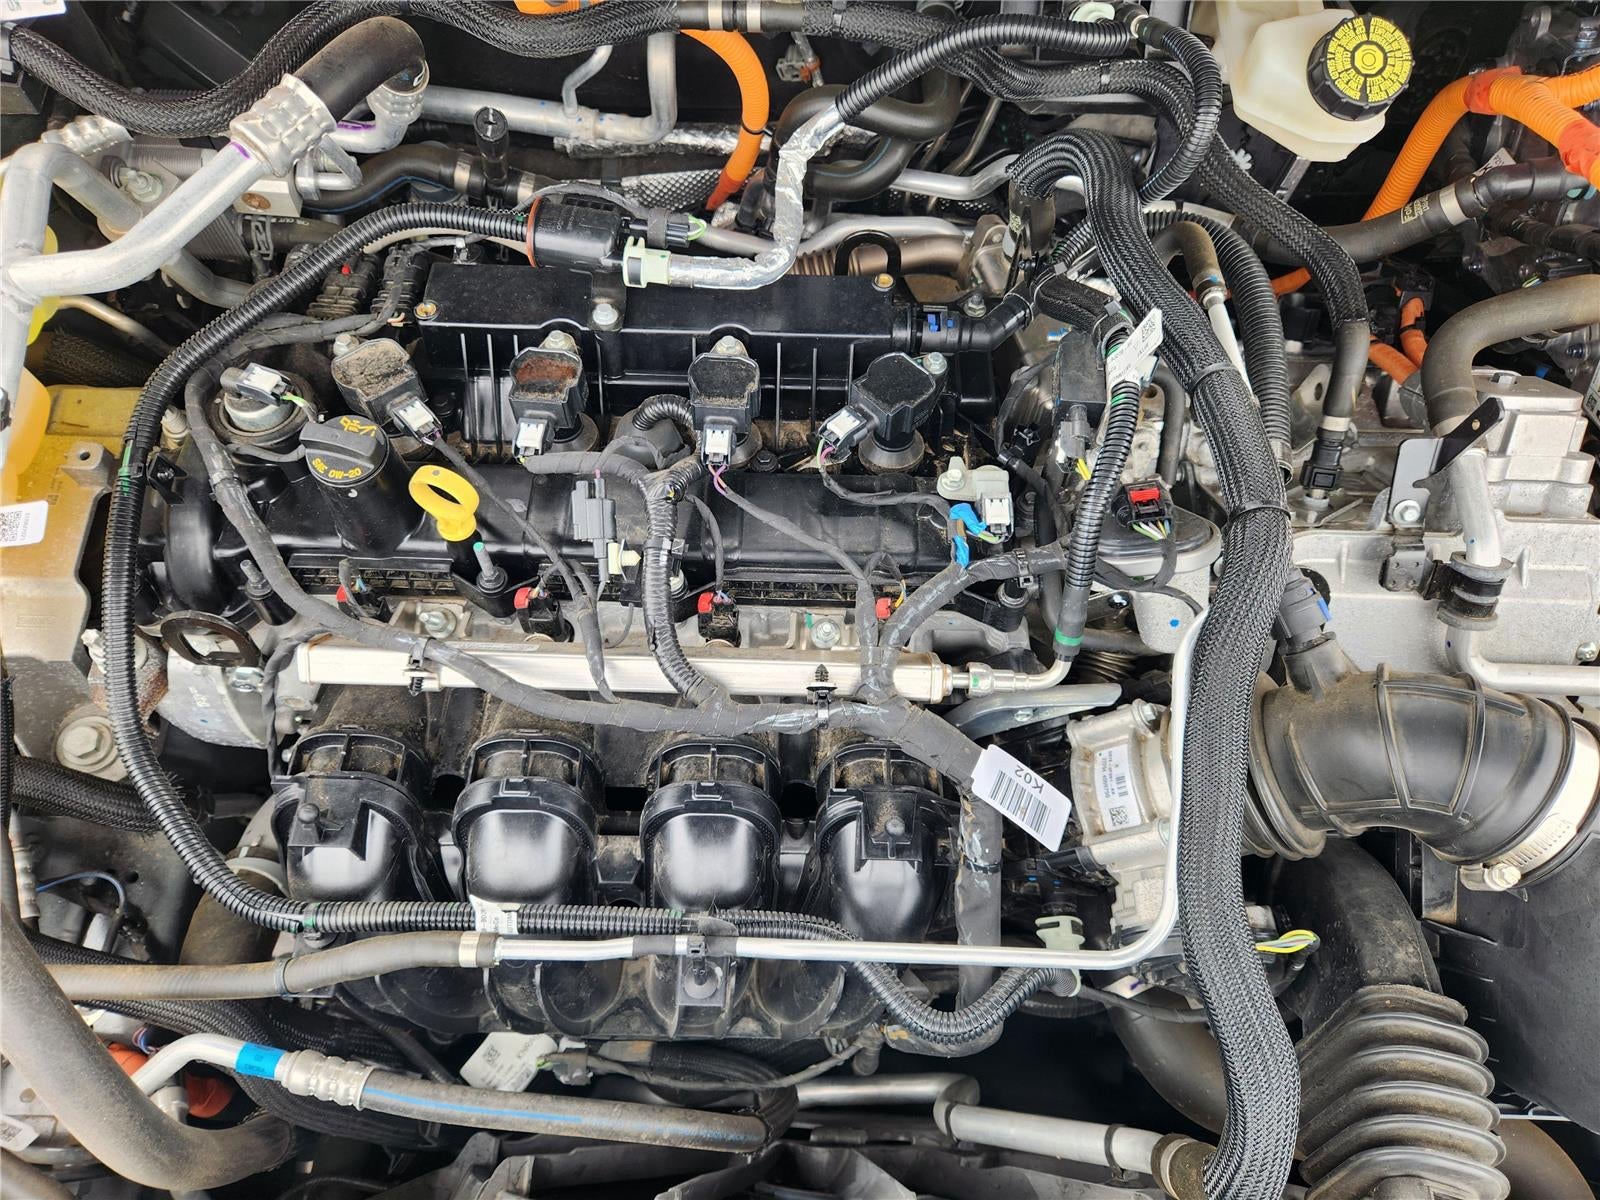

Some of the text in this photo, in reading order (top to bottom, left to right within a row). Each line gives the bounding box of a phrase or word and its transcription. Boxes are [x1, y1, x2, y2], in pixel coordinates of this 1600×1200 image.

[312, 458, 362, 479] SAE 0W-20
[1014, 764, 1045, 794] K02
